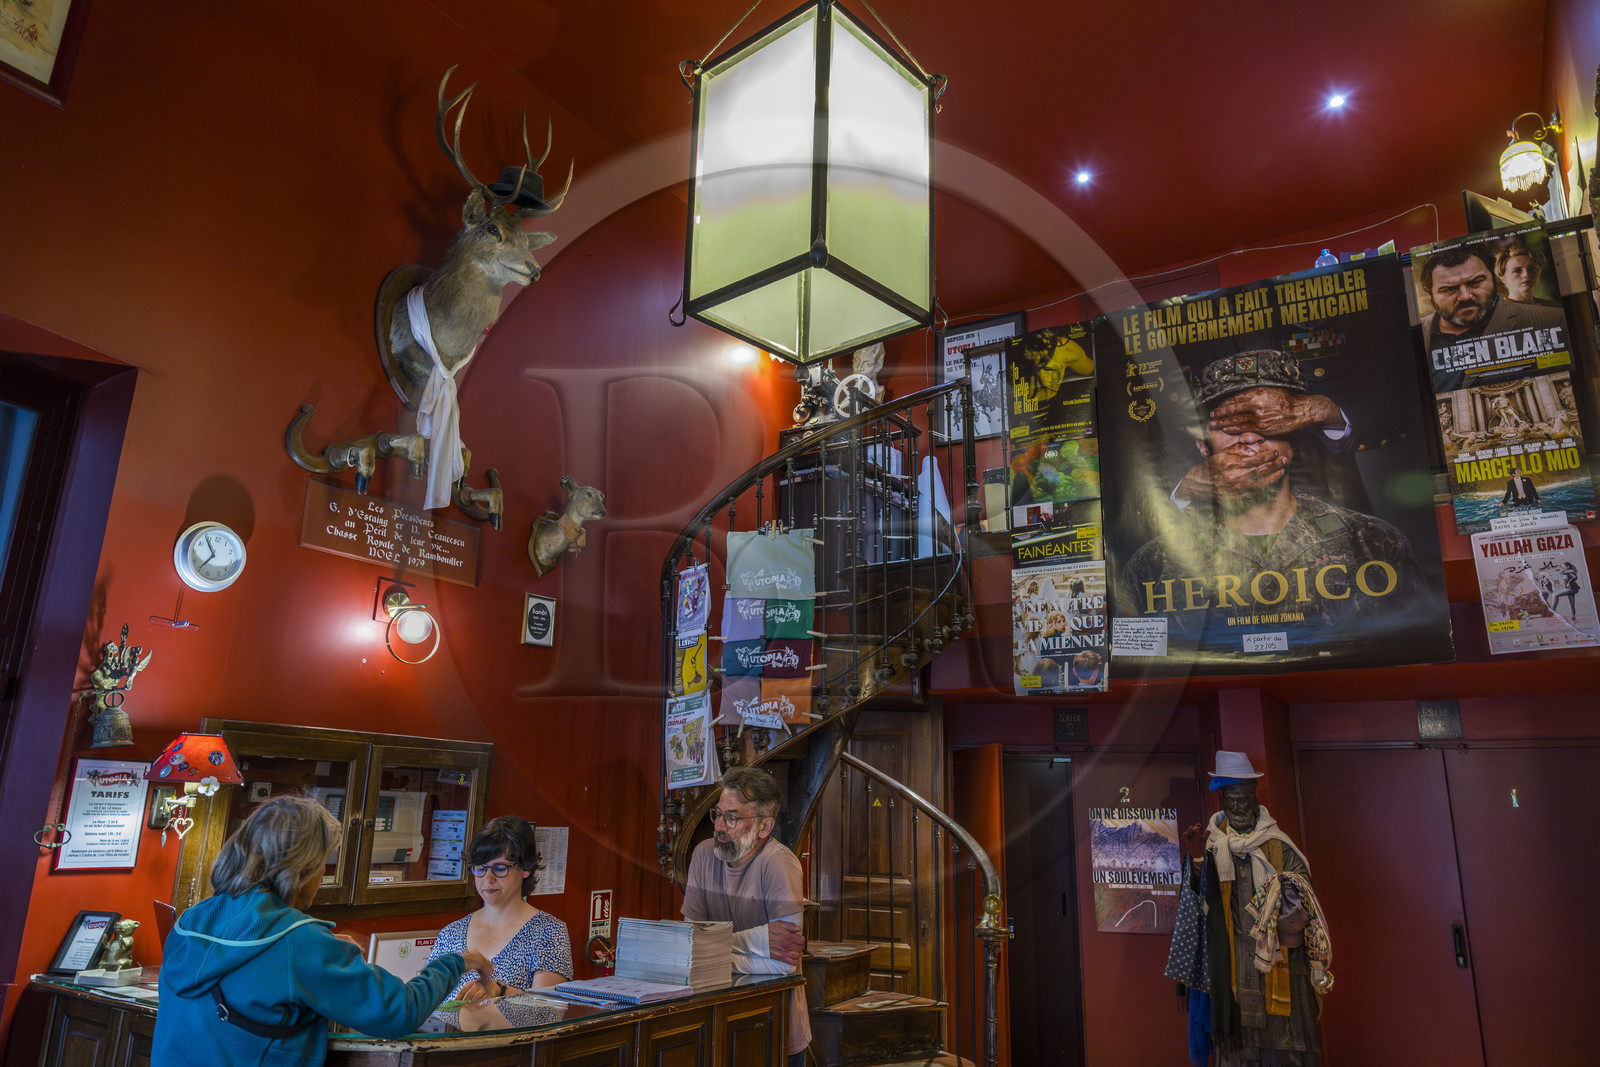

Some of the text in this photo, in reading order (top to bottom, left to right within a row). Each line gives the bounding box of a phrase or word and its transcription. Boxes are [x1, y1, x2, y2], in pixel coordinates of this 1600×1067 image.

[1123, 268, 1366, 336] LE FILM QUI A FAIT TREMBLER
[1125, 289, 1368, 355] LE GOUVERNEMENT MEXICAIN
[947, 342, 976, 356] UTOPIA
[1494, 326, 1564, 359] BLANC
[1455, 448, 1580, 484] MARCELLO MIO
[326, 525, 464, 567] Chasse Royale de Rambouillet
[394, 531, 402, 541] de
[410, 536, 425, 547] leur
[1480, 539, 1532, 558] YALLAH
[1537, 534, 1574, 552] GAZA
[408, 557, 425, 567] 1979
[755, 574, 785, 586] UTOPIA
[1143, 560, 1398, 614] HEROICO
[1015, 596, 1104, 614] UNE AUTRE
[1017, 615, 1104, 632] VIE QUE
[1228, 612, 1305, 626] UN FILM DE DAVID ZONANA
[1018, 639, 1037, 652] LA
[1041, 634, 1104, 650] MIENNE
[1253, 635, 1271, 644] partir
[750, 653, 783, 664] UTOPIA
[750, 702, 778, 714] UTOPIA
[100, 774, 128, 784] UTOPIA
[1120, 786, 1130, 802] 2
[1090, 808, 1176, 820] ON NE DISSOUT PAS
[1094, 871, 1106, 883] UN
